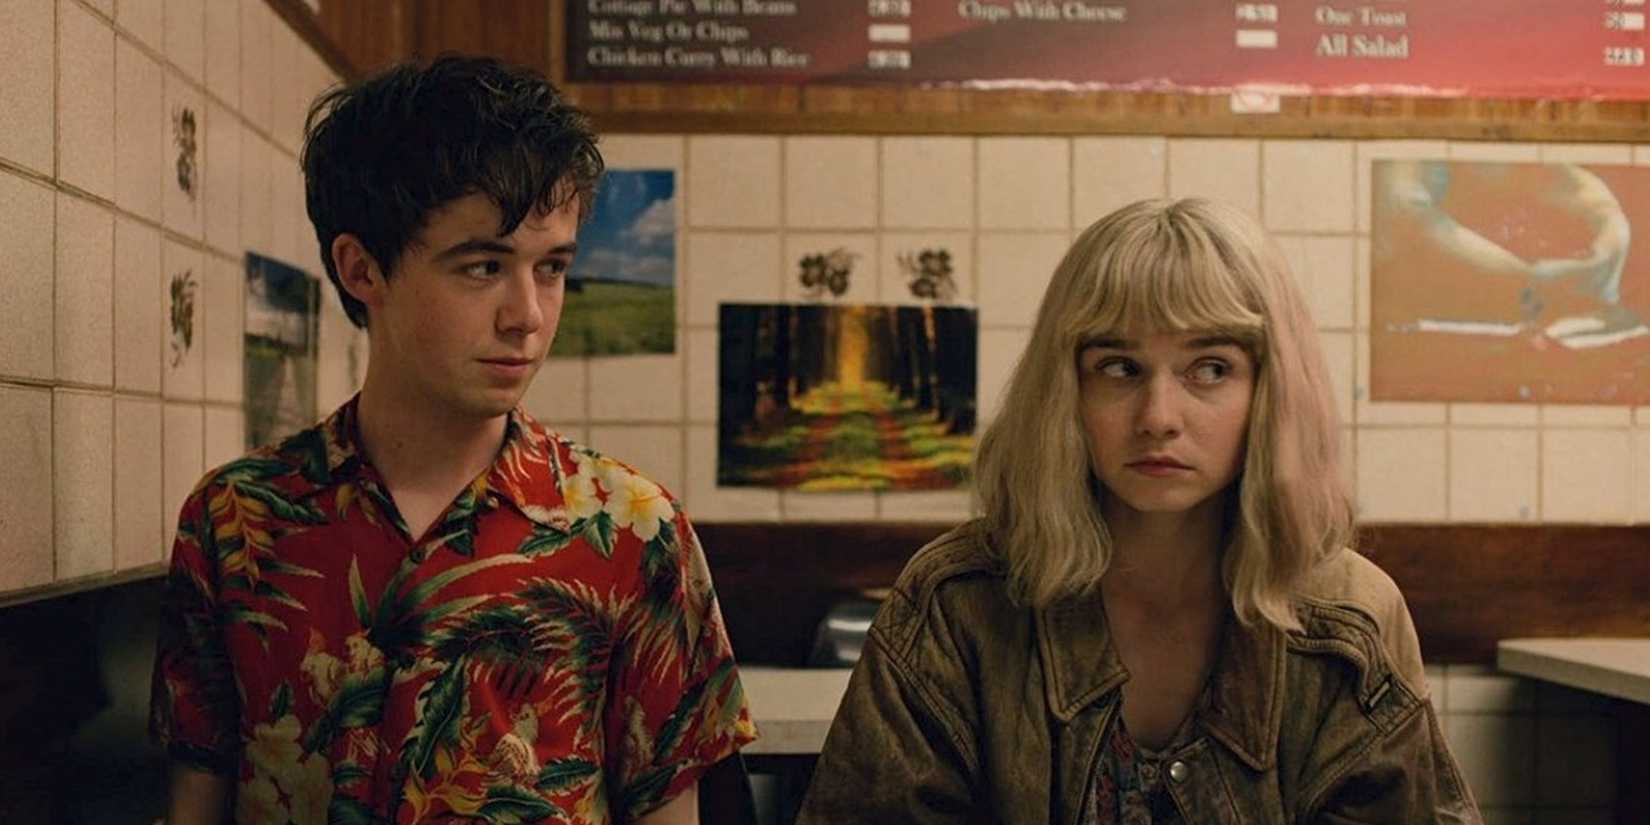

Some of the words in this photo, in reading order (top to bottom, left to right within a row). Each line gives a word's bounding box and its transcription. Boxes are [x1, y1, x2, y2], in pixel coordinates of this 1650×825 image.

[692, 0, 739, 14] With
[957, 0, 1012, 22] Chips
[1014, 0, 1061, 19] With
[1062, 0, 1128, 20] Cheese
[1315, 5, 1352, 25] One
[627, 20, 663, 42] Veg
[665, 21, 692, 40] Or
[696, 21, 750, 42] Chips
[1316, 33, 1348, 57] All
[1353, 33, 1409, 58] Salad
[587, 47, 662, 66] Chicken
[665, 47, 716, 68] Curry
[720, 48, 768, 66] With
